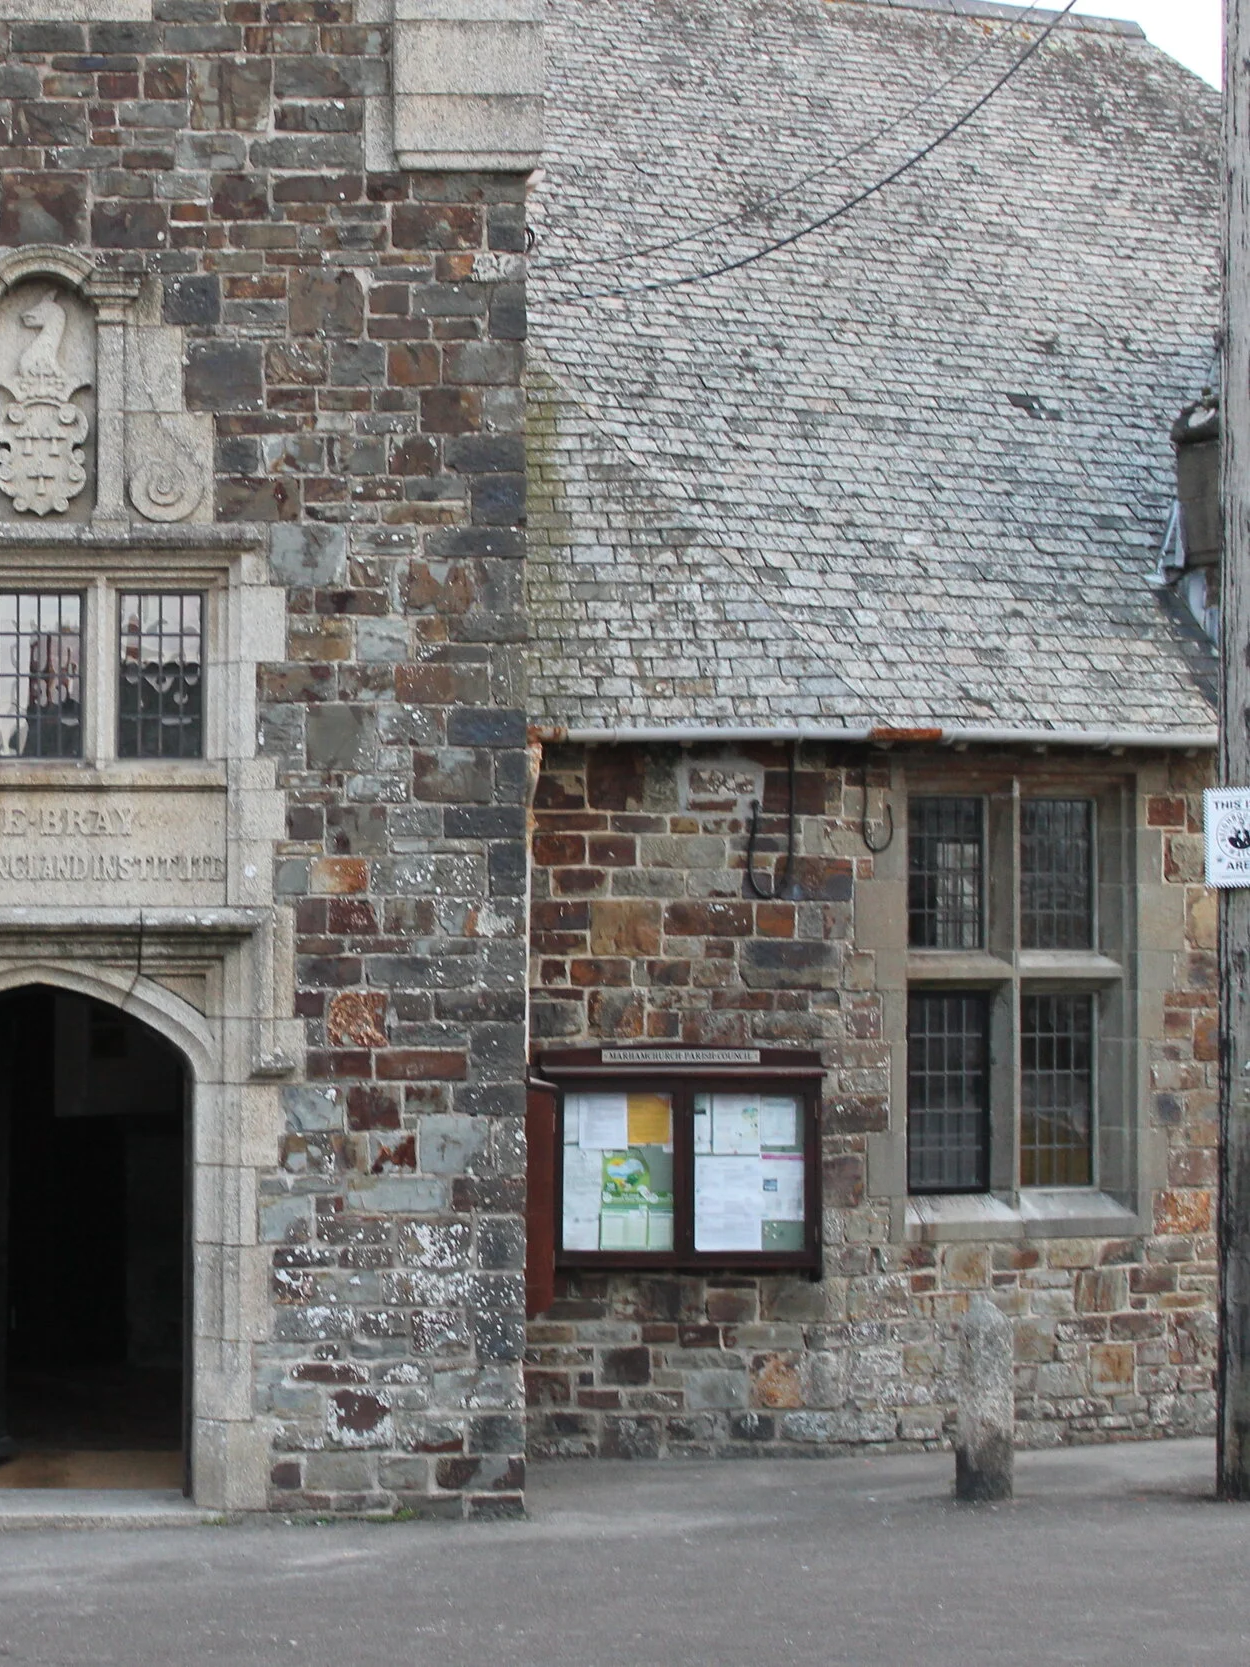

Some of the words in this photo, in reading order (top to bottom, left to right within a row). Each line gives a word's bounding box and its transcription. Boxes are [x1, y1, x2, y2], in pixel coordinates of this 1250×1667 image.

[1214, 799, 1241, 810] THIS
[39, 807, 136, 837] BRAY
[91, 854, 227, 881] INSTITUTE
